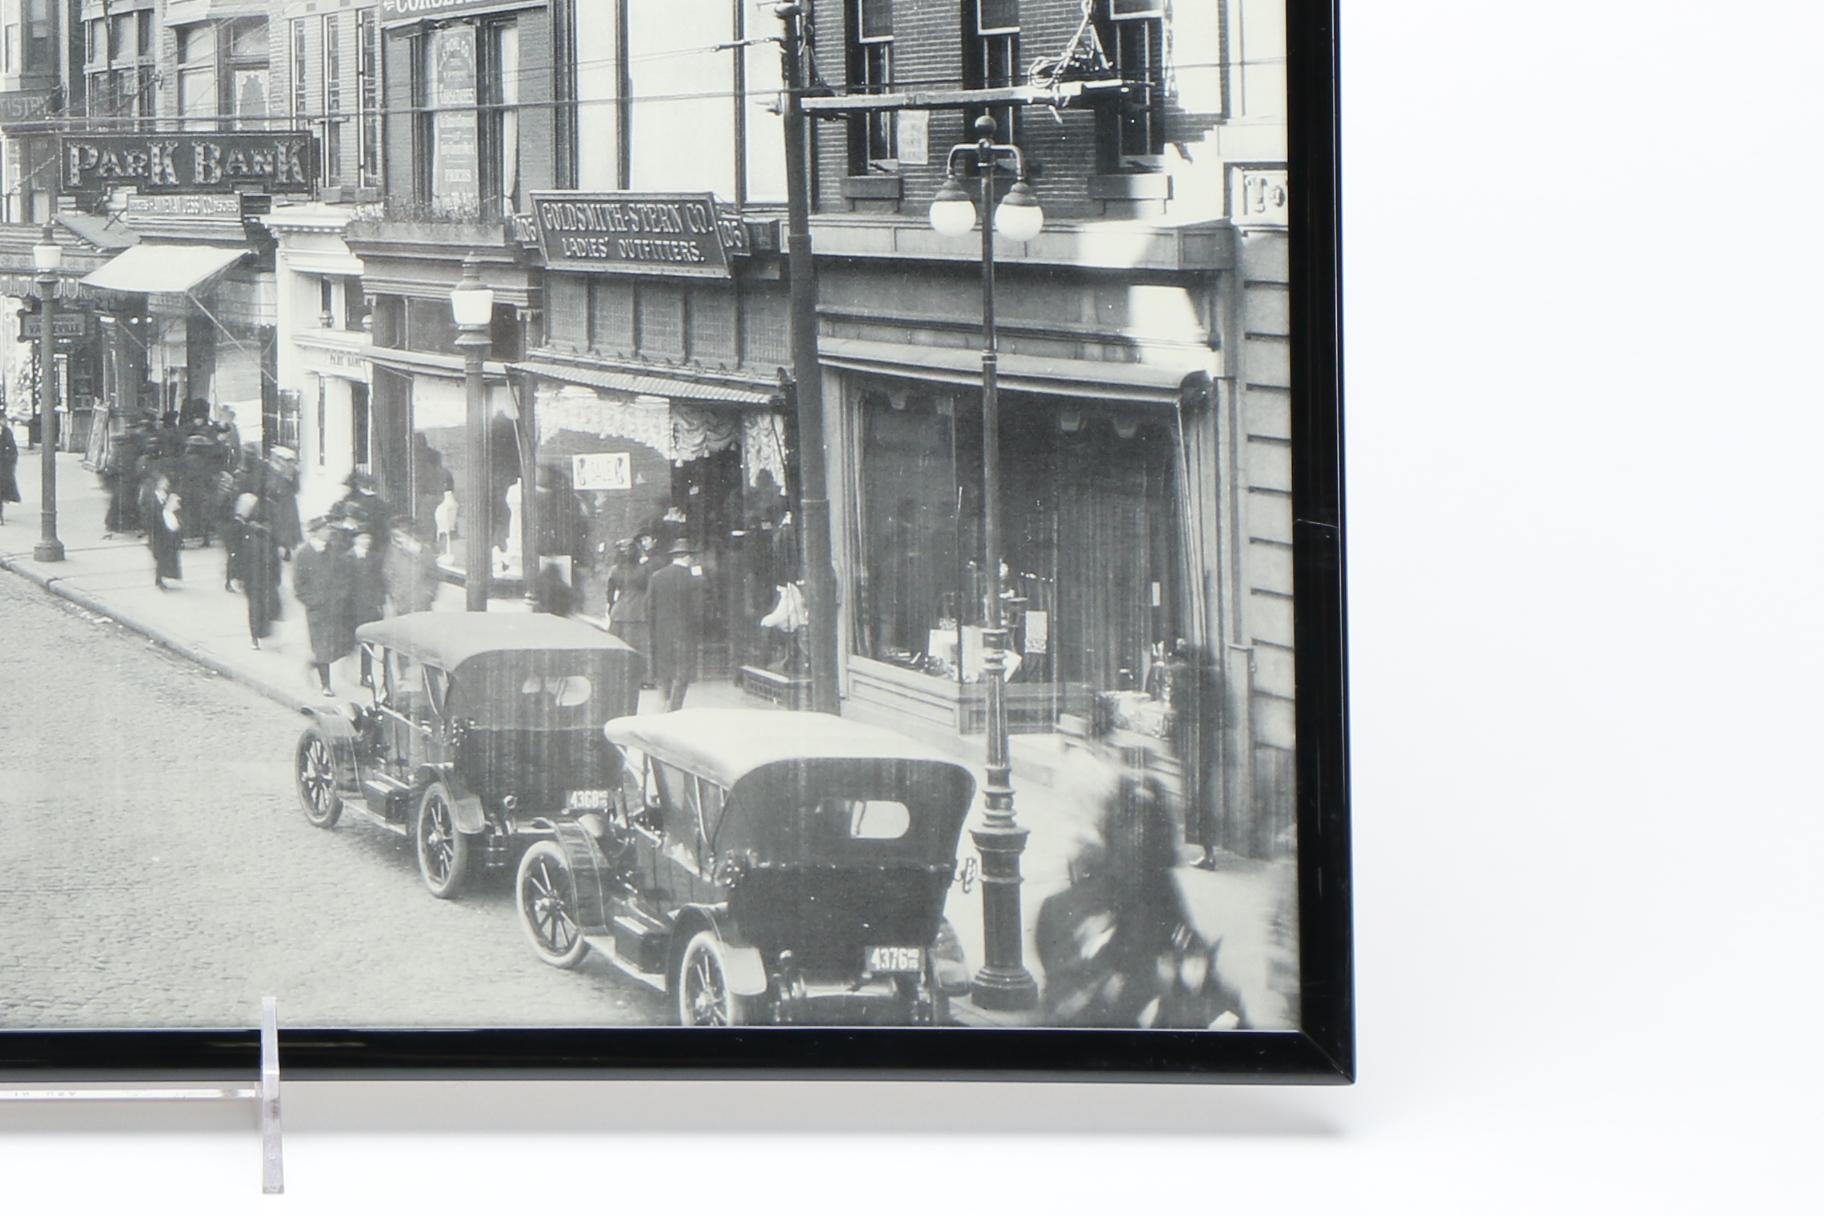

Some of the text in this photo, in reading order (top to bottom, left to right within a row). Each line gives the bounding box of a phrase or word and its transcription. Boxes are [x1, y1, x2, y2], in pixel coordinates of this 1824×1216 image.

[67, 140, 305, 186] PARK BANK
[542, 202, 684, 233] GOLDSMITH-STERN
[562, 236, 705, 262] LADIES' OUTFITTERS.
[870, 947, 908, 971] 4376
